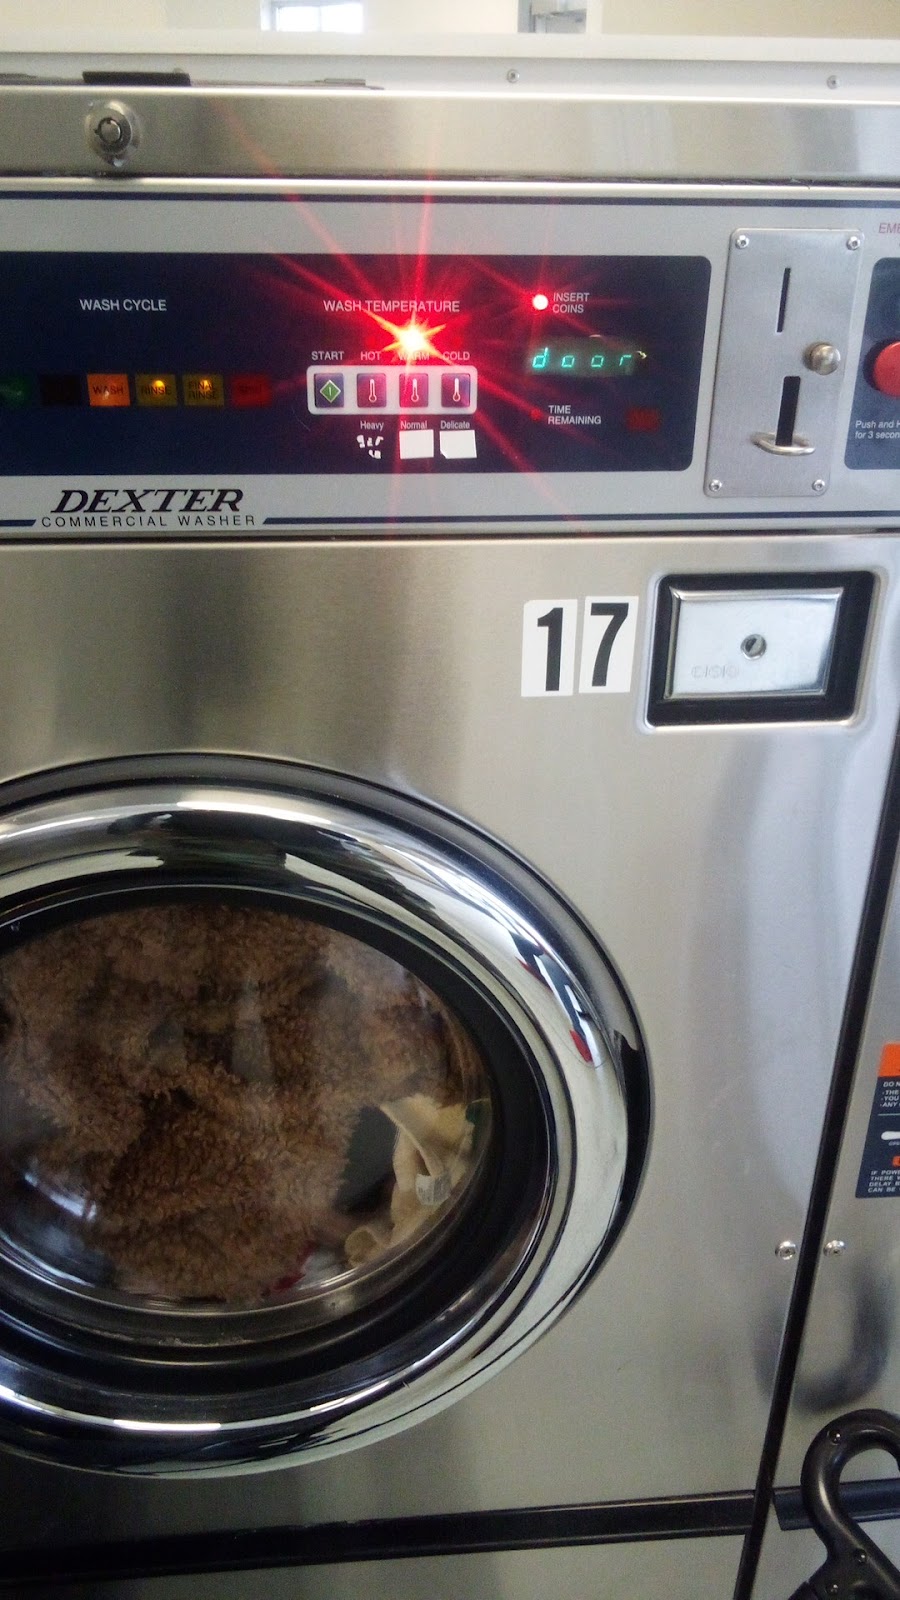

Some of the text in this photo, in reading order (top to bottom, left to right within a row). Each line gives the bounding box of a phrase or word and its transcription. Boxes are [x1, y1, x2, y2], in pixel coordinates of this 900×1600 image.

[553, 292, 590, 302] INSERT
[79, 299, 167, 311] WASH CYCLE
[323, 300, 460, 312] WASH TEMPERATURE
[552, 304, 584, 313] COINS
[311, 351, 344, 360] START
[360, 351, 381, 361] HOT
[442, 351, 470, 361] COLD
[531, 347, 632, 369] door
[92, 385, 124, 394] WASH
[141, 384, 172, 396] RINSE
[548, 405, 571, 414] TIME
[547, 415, 602, 425] REMAINING
[855, 420, 876, 429] Push
[878, 420, 894, 429] and
[360, 421, 384, 431] Heavy
[400, 421, 428, 430] Normal
[440, 421, 470, 430] Delicate
[855, 430, 866, 439] for
[867, 430, 874, 439] 3
[50, 489, 244, 513] DEXTER
[41, 515, 255, 527] COMMERCIAL WASHER
[537, 602, 629, 692] 17
